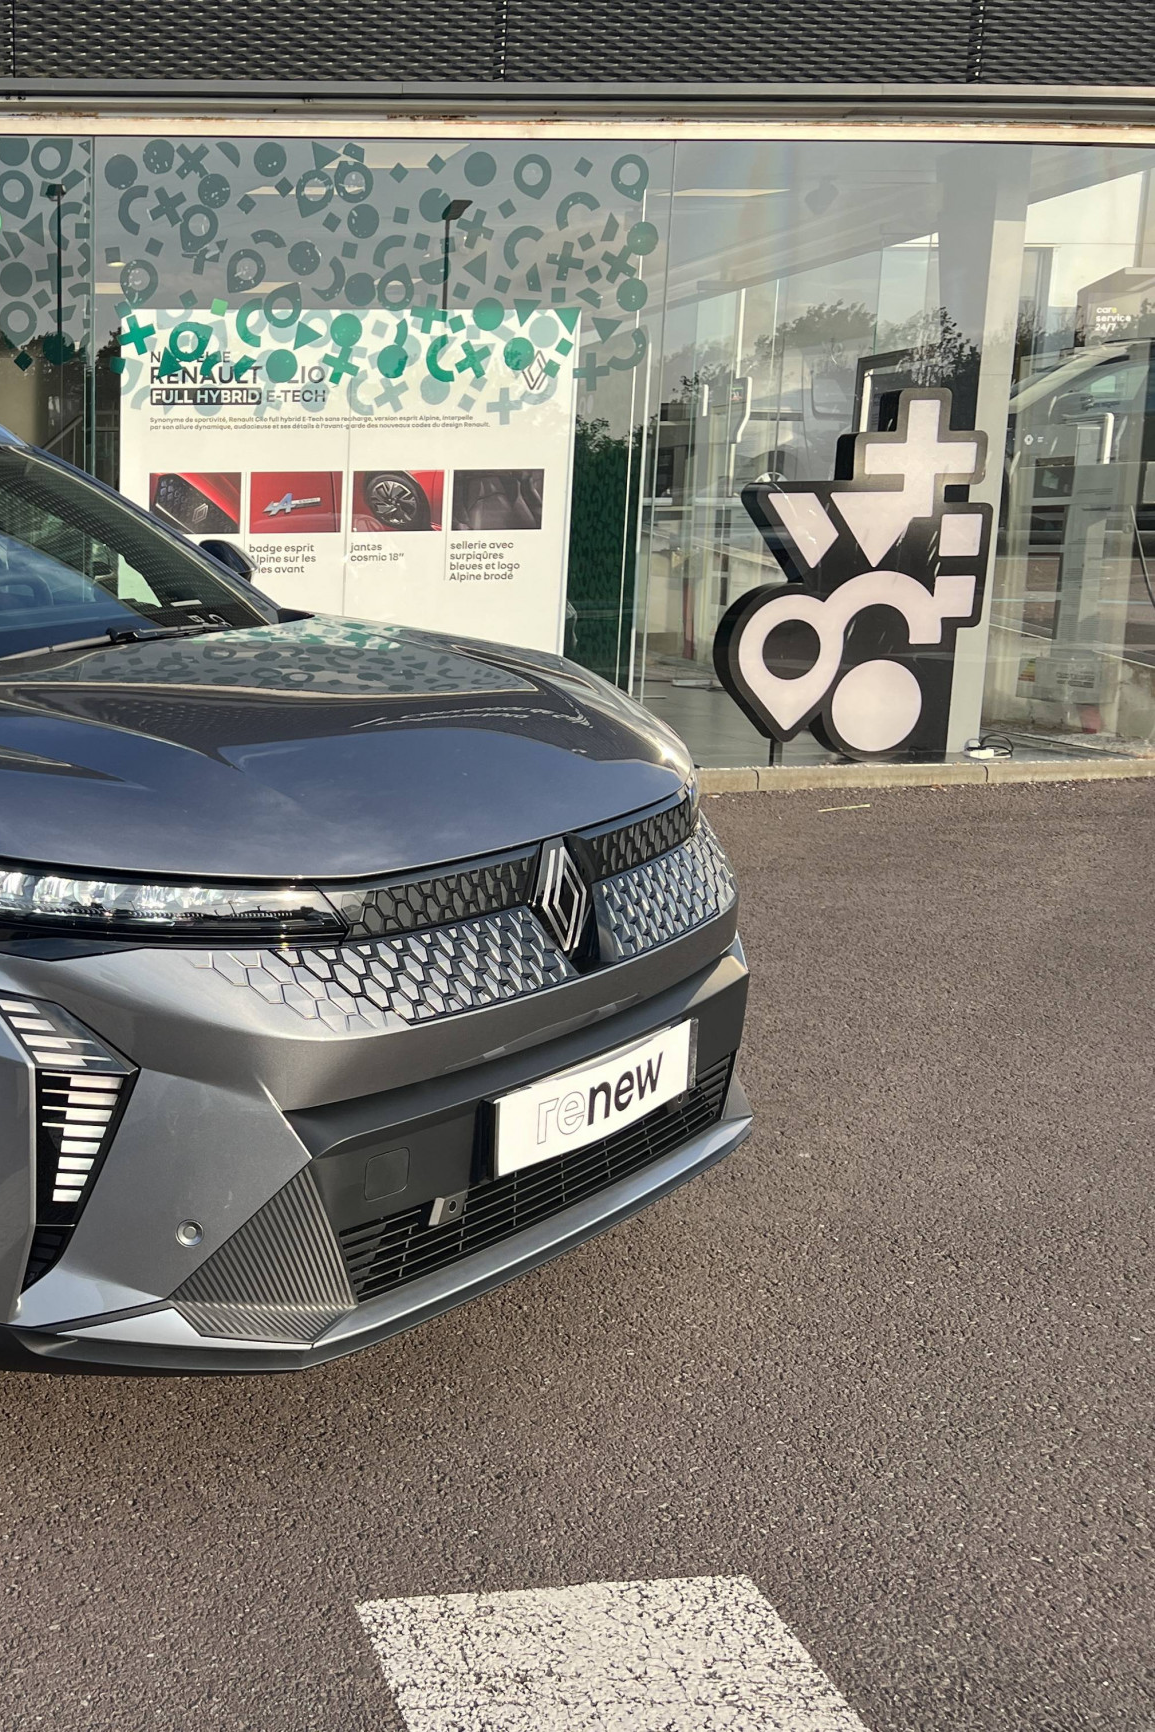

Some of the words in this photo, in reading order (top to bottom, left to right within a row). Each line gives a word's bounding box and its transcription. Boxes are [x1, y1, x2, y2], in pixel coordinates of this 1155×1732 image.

[1096, 314, 1132, 322] service
[1095, 323, 1117, 333] 24/7
[152, 390, 193, 404] FULL
[197, 389, 261, 404] HYBRID
[266, 389, 326, 403] E-TECH
[150, 416, 184, 424] Synonyme
[195, 416, 228, 424] sportivité,
[280, 415, 302, 423] hybrid
[341, 415, 373, 423] recharge,
[249, 543, 283, 555] badge
[284, 543, 315, 555] esprit
[350, 542, 383, 554] jantes
[450, 540, 487, 549] sellerie
[251, 554, 281, 566] lpine
[283, 555, 300, 563] sur
[301, 554, 316, 563] les
[350, 552, 387, 562] cosmic
[450, 551, 504, 561] surpiqûres
[274, 565, 305, 573] avant
[450, 562, 483, 571] bleues
[485, 562, 496, 570] et
[498, 561, 521, 571] logo
[449, 572, 482, 583] Alpine
[483, 571, 514, 580] brodé
[537, 1051, 664, 1145] renew
